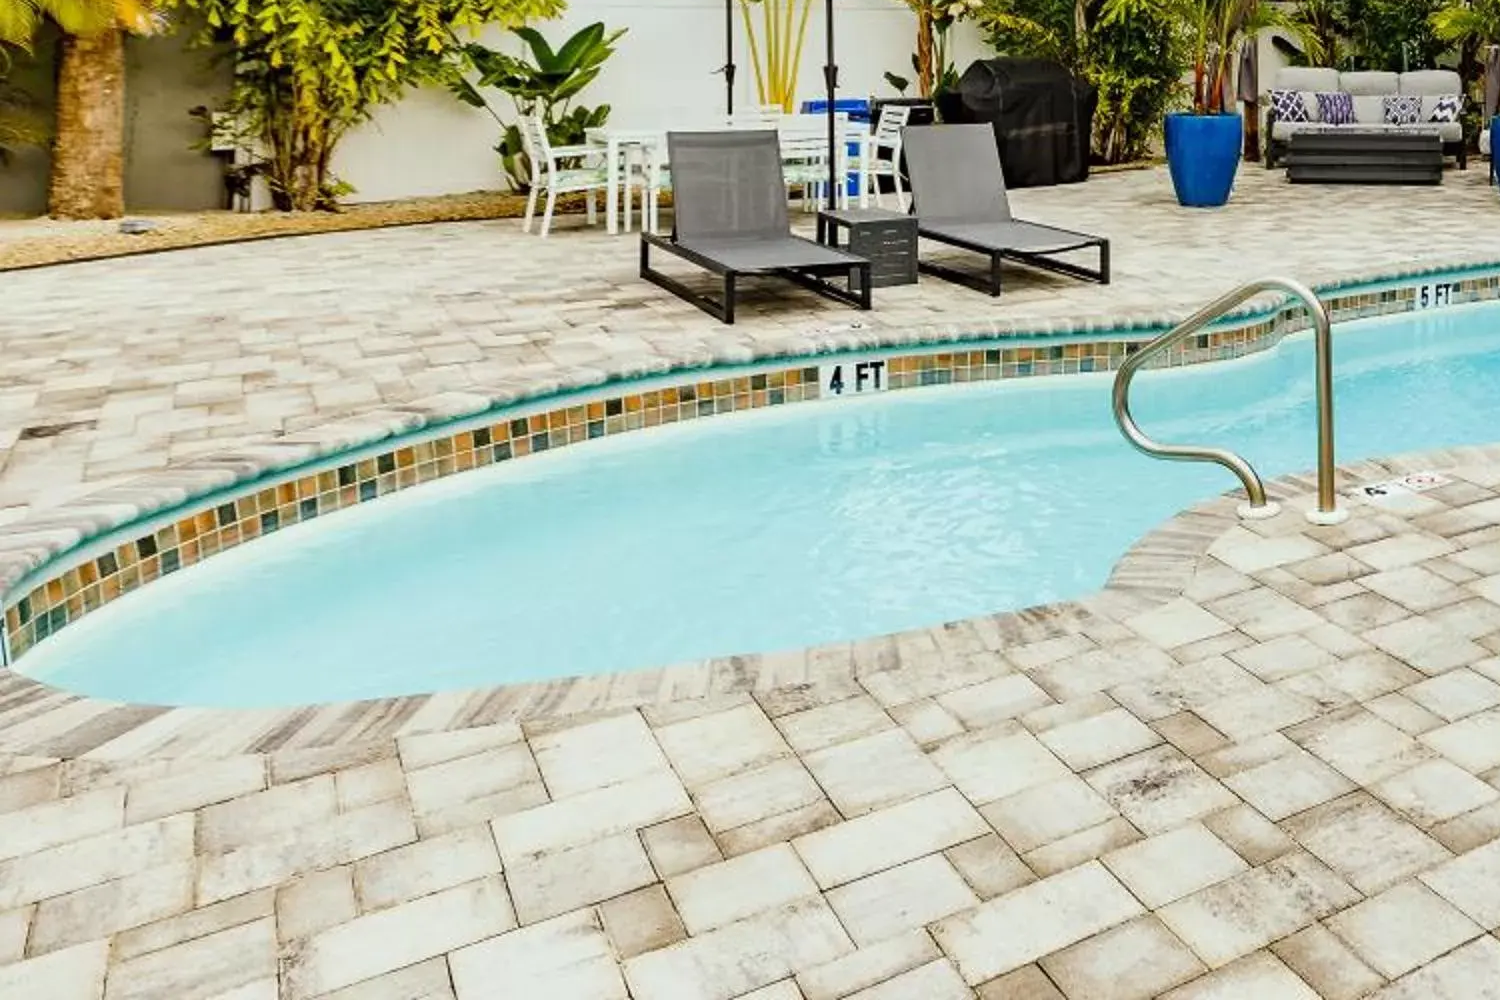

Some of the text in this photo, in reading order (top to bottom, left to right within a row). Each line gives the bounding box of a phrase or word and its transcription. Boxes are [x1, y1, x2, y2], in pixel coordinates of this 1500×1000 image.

[1421, 283, 1451, 308] 5 FT
[829, 361, 885, 395] 4 FT
